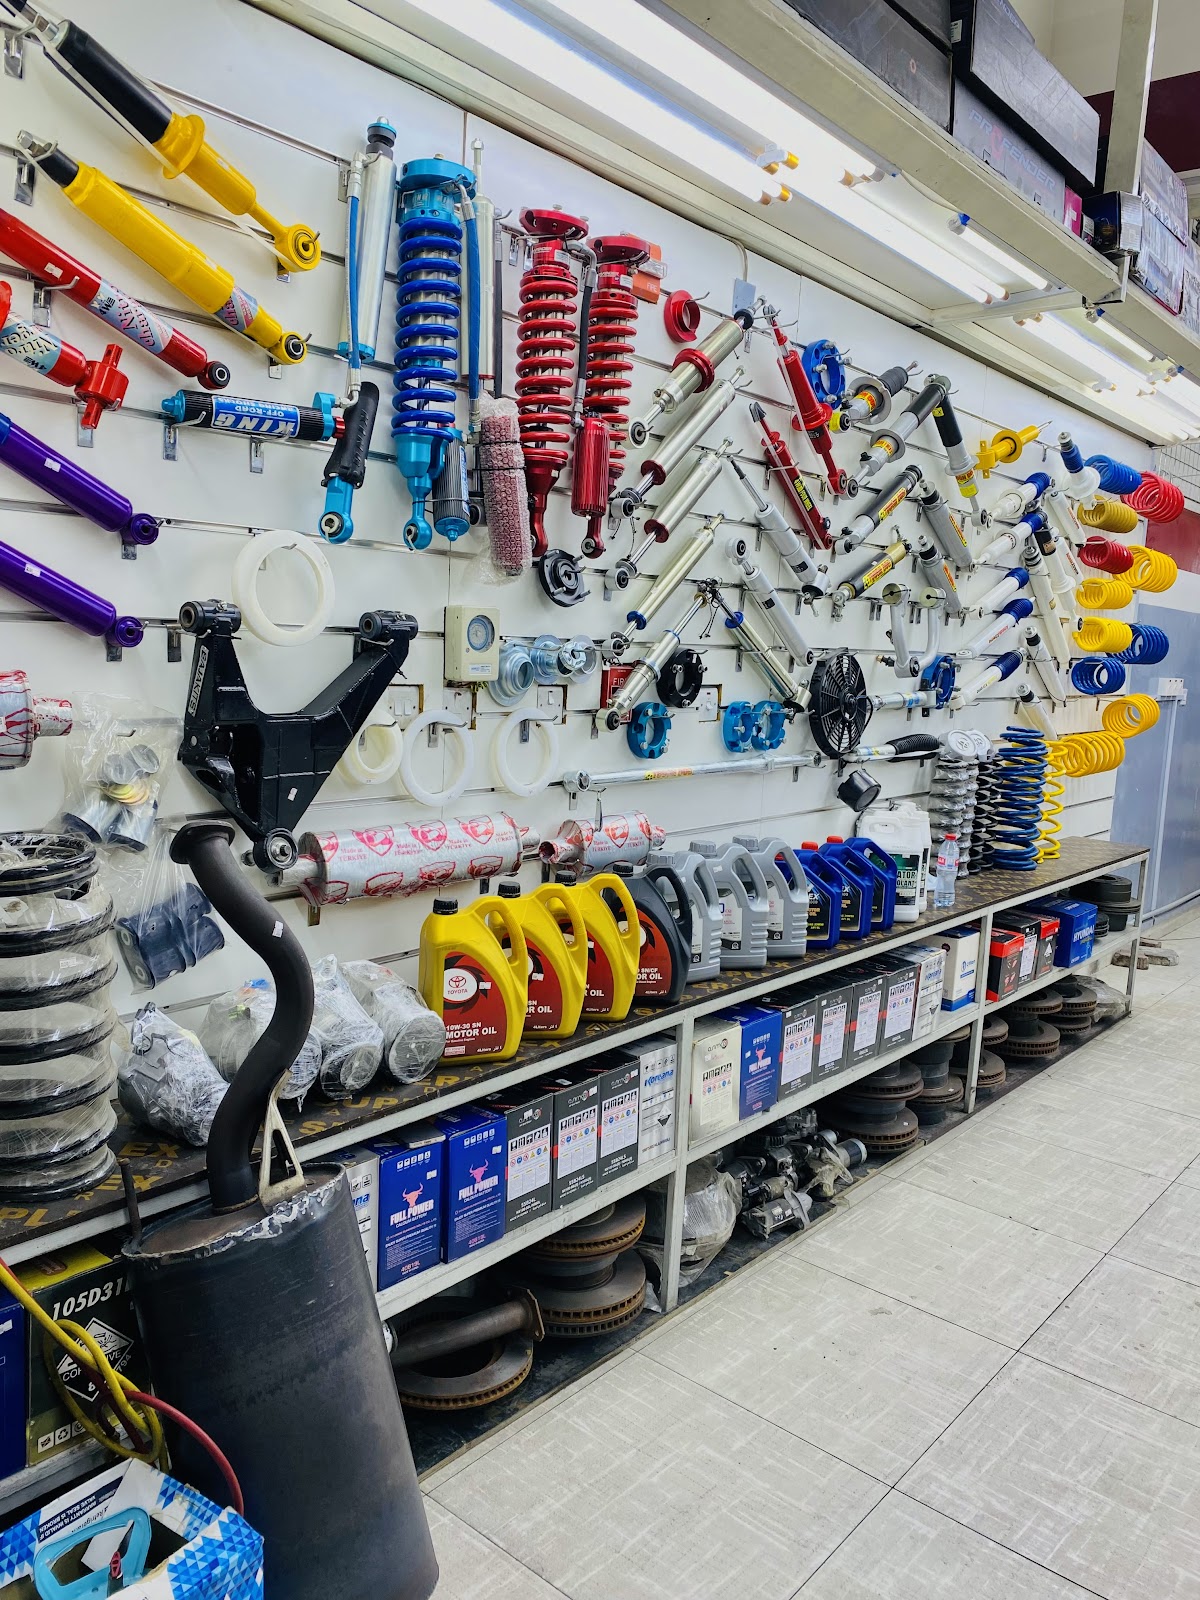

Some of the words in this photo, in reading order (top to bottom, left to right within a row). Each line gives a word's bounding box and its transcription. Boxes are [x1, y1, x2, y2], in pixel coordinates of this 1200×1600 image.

[968, 109, 1056, 189] PROFENDER
[234, 405, 285, 418] OFF-ROAD
[214, 413, 296, 434] KING
[189, 648, 209, 712] BAJAKITS
[612, 678, 629, 686] FIR
[896, 870, 916, 879] ATOR
[1073, 924, 1095, 943] HYUNDAI
[649, 973, 663, 981] OIL
[589, 989, 605, 997] OIL
[537, 1005, 553, 1014] OIL
[446, 1023, 471, 1032] 10W-30
[472, 1021, 482, 1029] SN
[446, 1028, 479, 1040] MOTOR
[482, 1026, 498, 1036] OIL
[643, 1068, 674, 1087] Koreana
[458, 1186, 473, 1201] FULL
[472, 1174, 499, 1195] POWER
[389, 1209, 408, 1227] FULL
[407, 1198, 434, 1219] POWER
[67, 1505, 81, 1516] SEAL
[69, 1500, 98, 1521] WARRANTY
[39, 1517, 61, 1533] BROKEN
